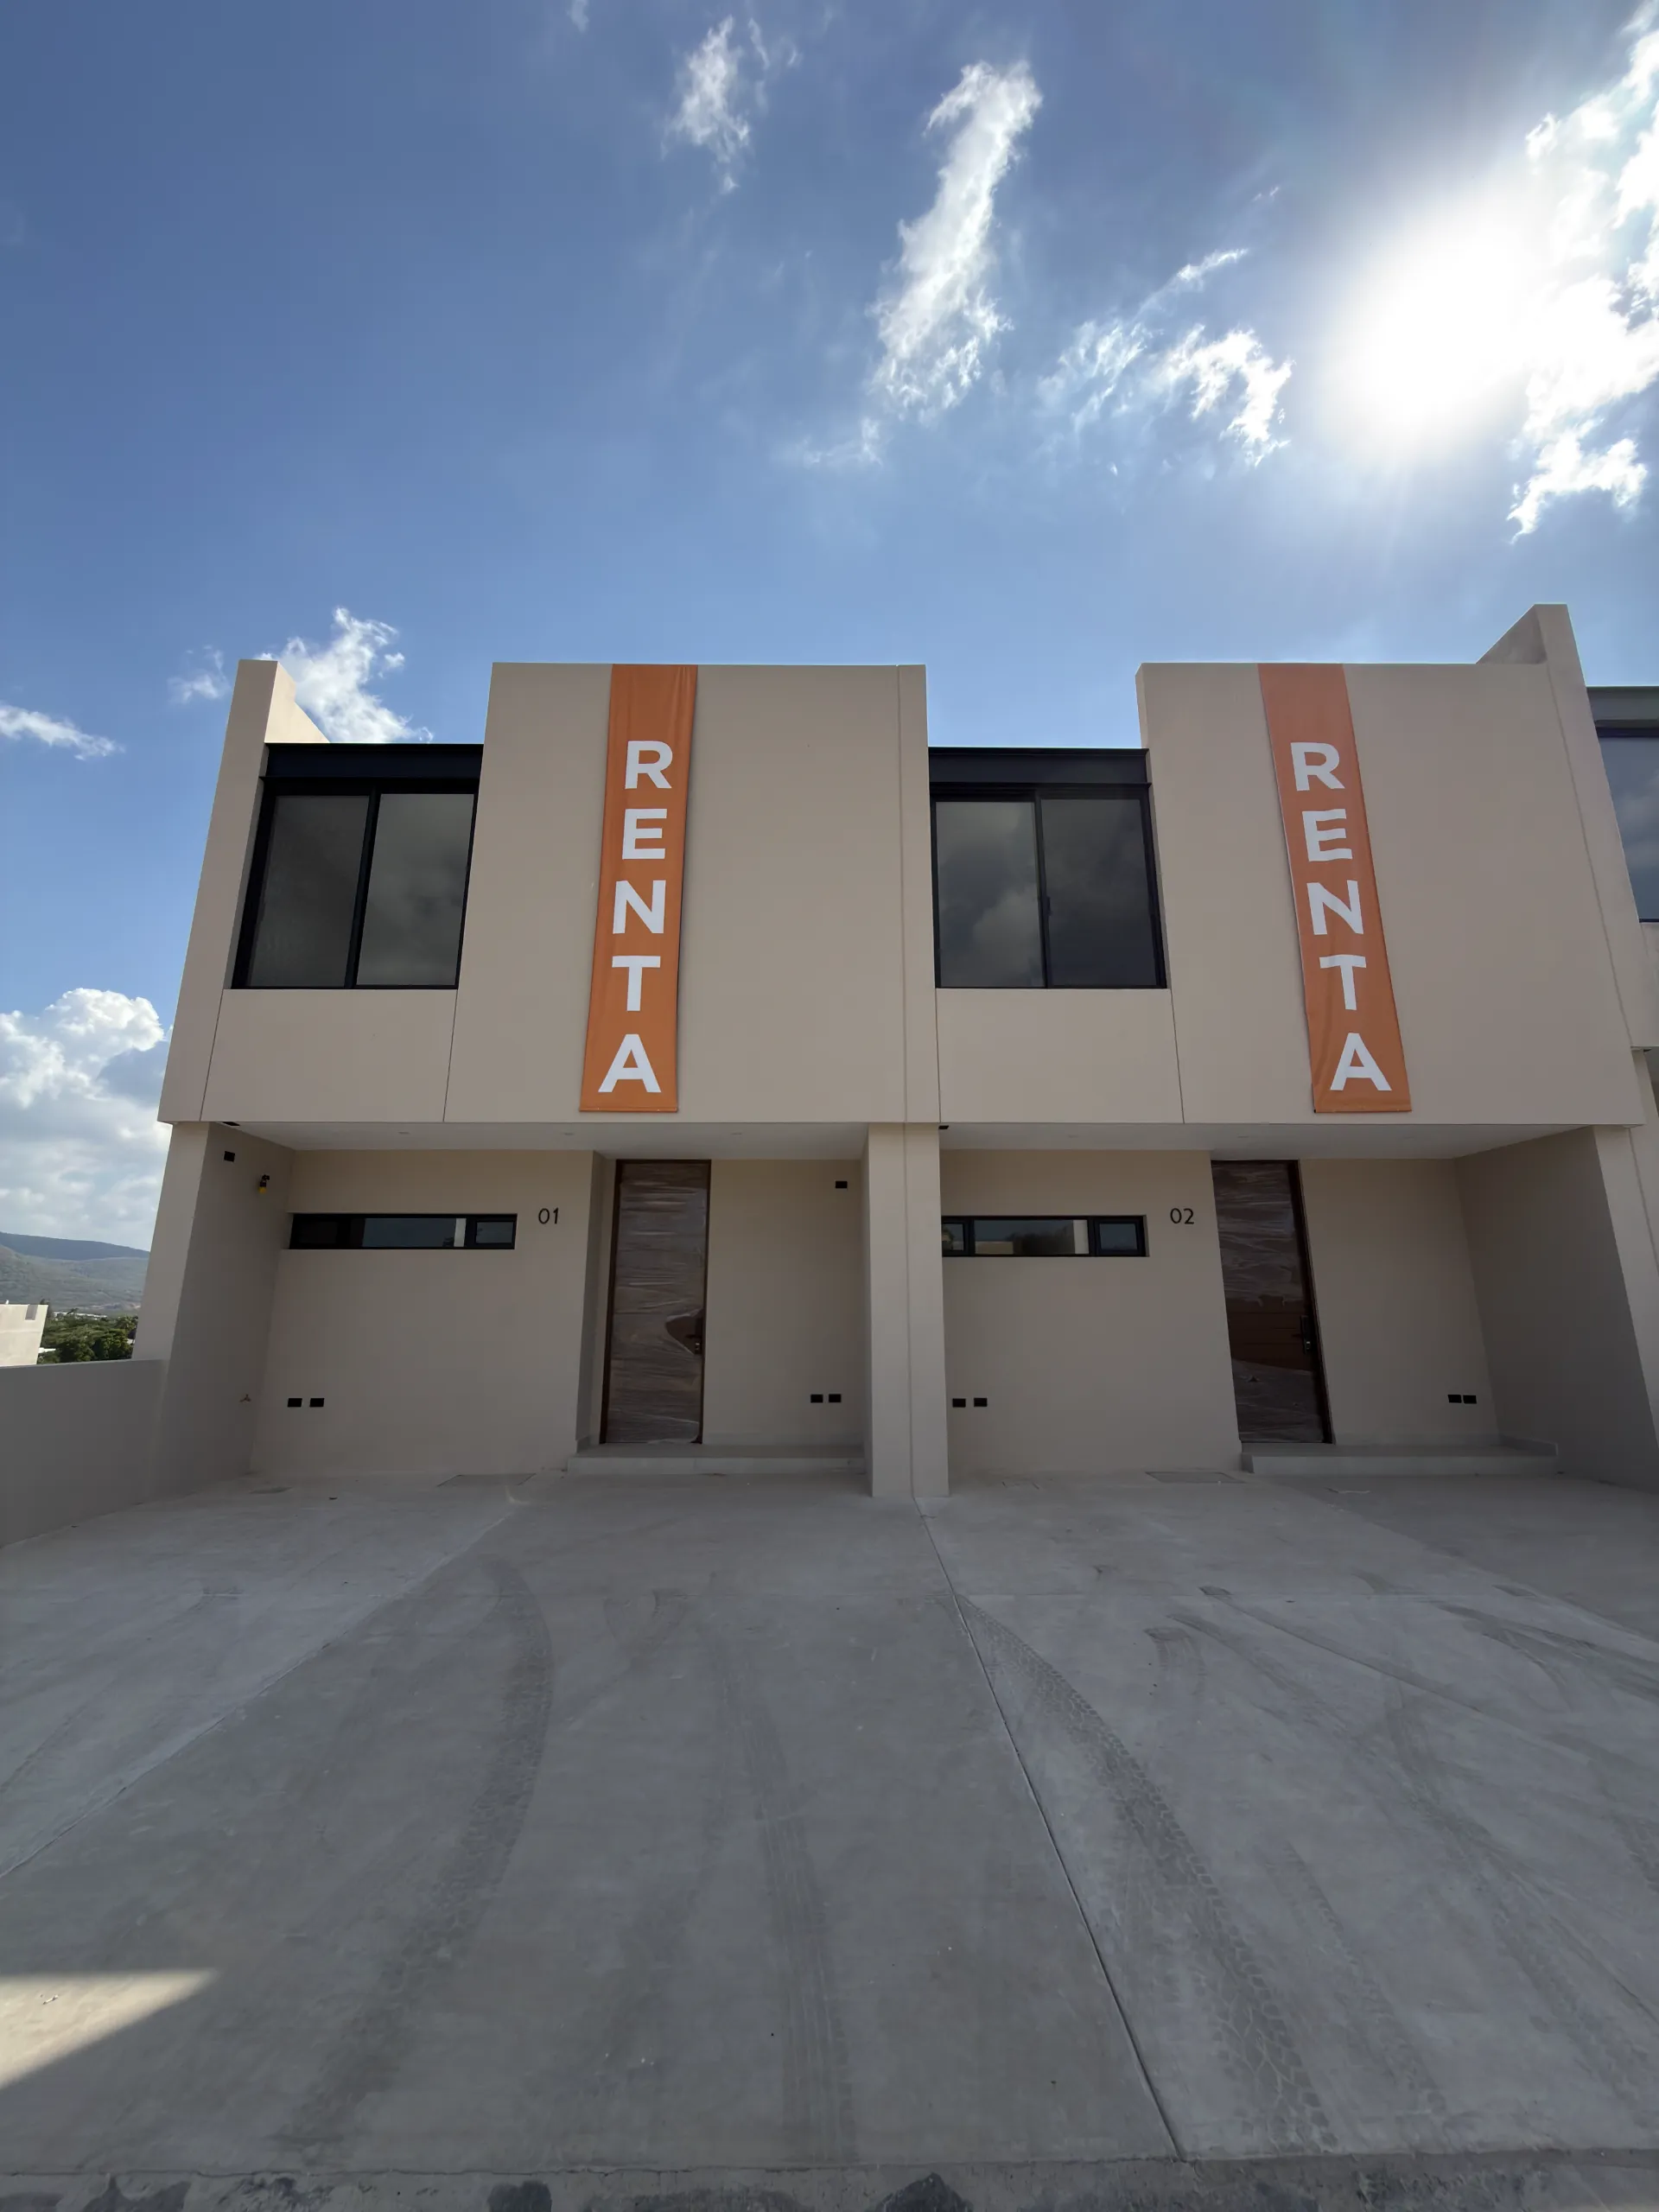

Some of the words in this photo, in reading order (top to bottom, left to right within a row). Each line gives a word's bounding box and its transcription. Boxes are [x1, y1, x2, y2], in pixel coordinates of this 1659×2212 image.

[598, 741, 673, 1093] RENTA
[1290, 742, 1391, 1091] RENTA
[537, 1206, 559, 1224] 01
[1169, 1207, 1195, 1224] 02
